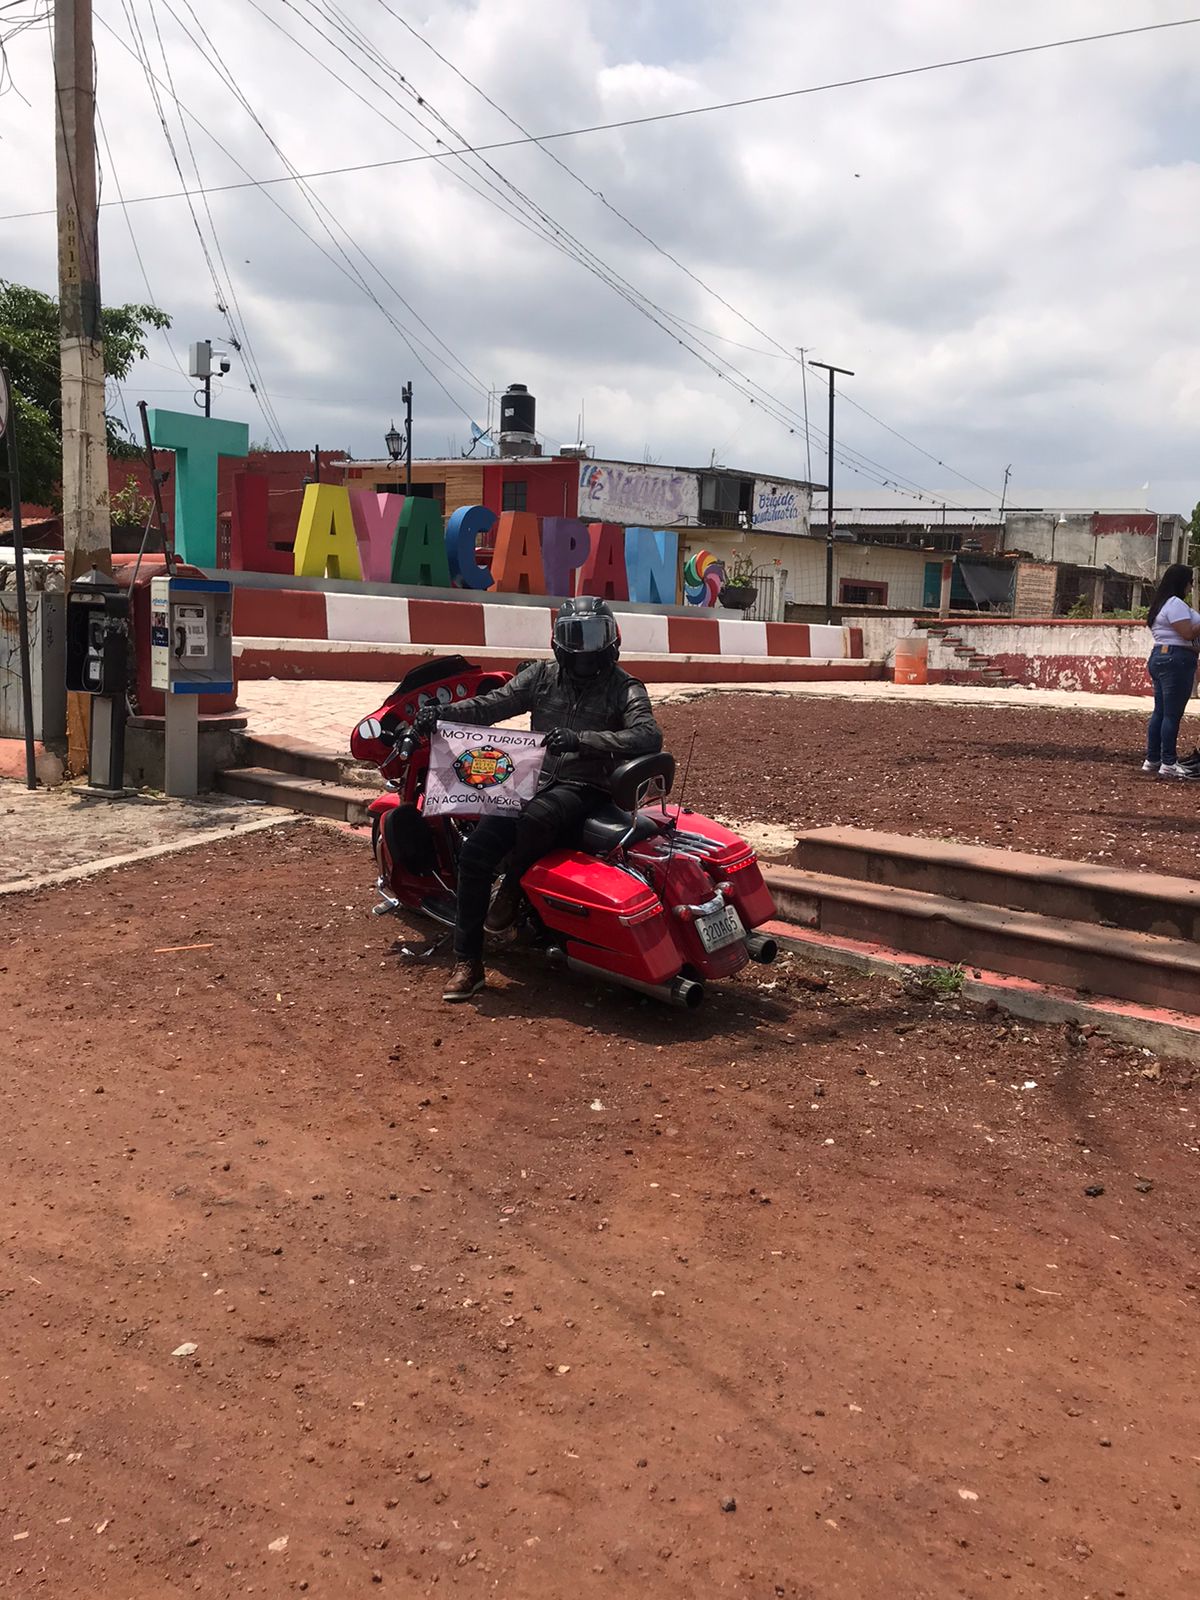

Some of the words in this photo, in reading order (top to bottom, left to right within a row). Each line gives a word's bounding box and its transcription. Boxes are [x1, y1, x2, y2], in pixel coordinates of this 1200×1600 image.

[149, 408, 679, 606] TLAYACAPAN
[442, 730, 483, 741] MOTO
[487, 734, 536, 747] TURISTA
[426, 796, 440, 806] EN
[441, 792, 486, 805] ACCIÓN
[487, 795, 527, 809] MÉXICO
